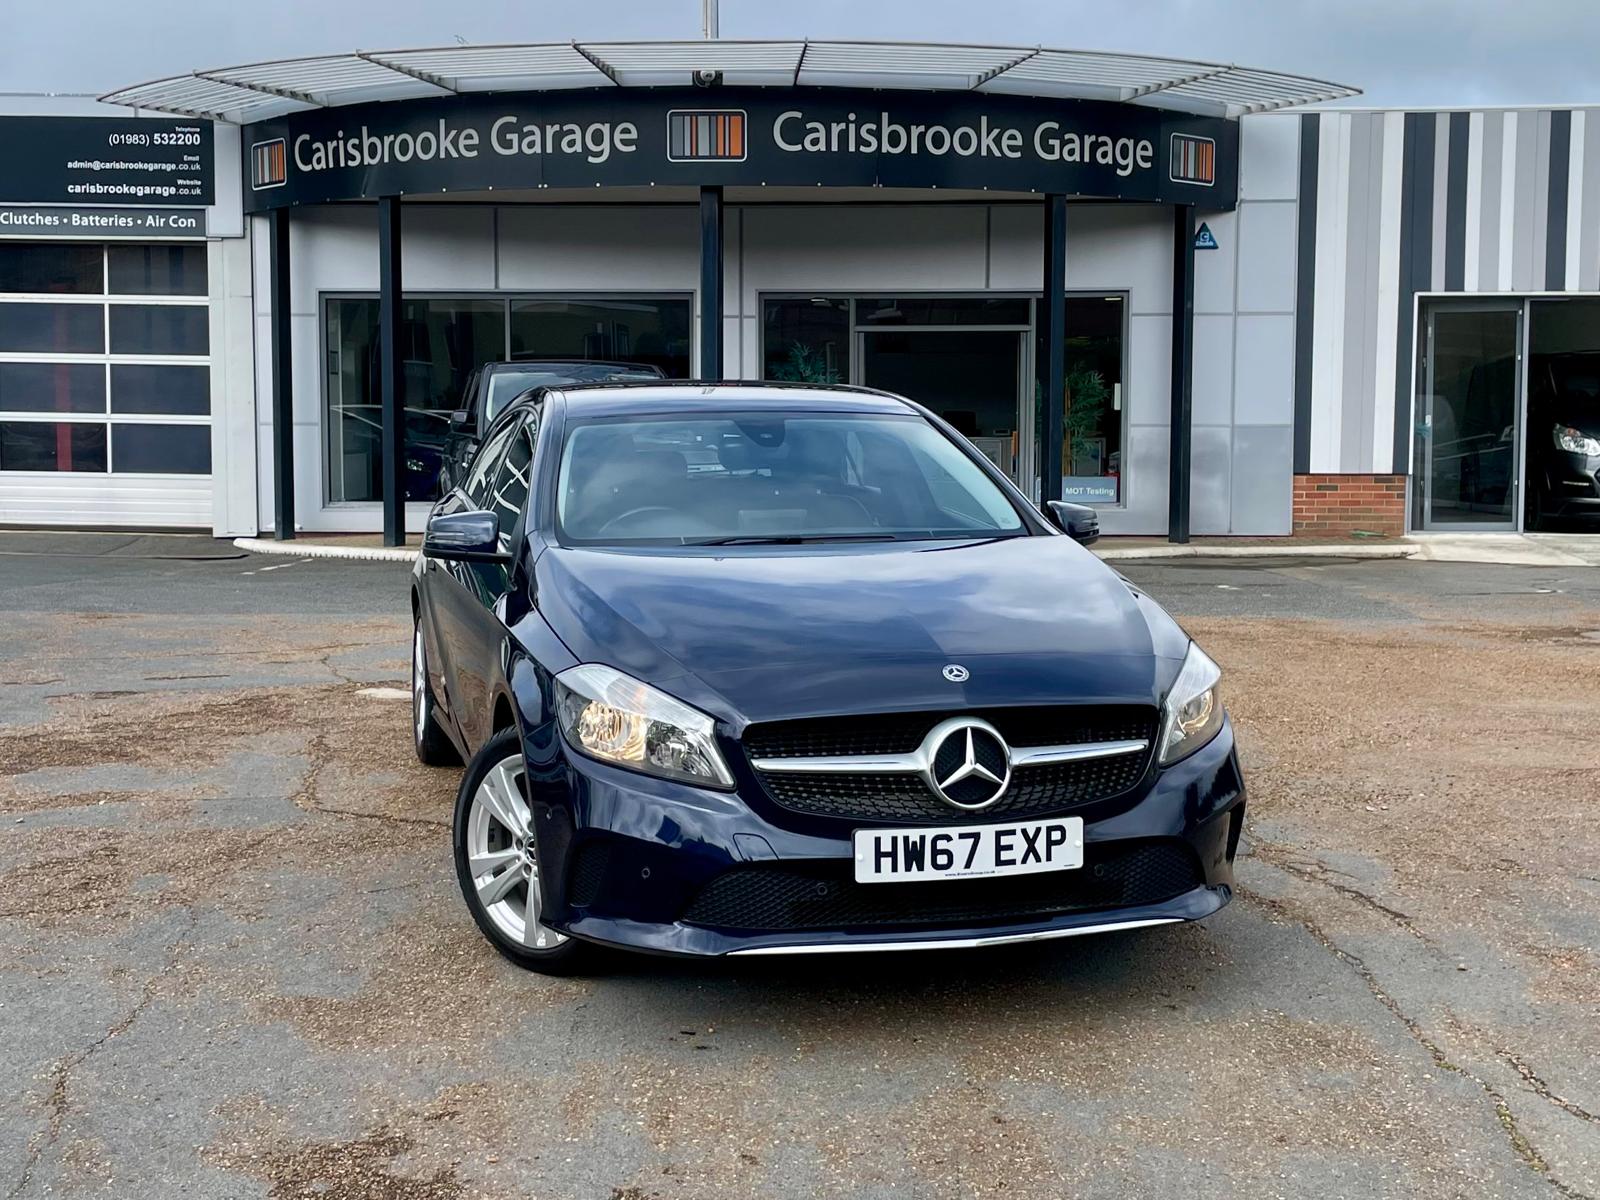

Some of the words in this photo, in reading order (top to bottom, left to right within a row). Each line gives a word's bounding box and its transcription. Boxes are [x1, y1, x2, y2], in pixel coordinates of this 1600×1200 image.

[108, 133, 150, 147] (01983)
[153, 133, 201, 145] 532200
[294, 118, 480, 172] Carisbrooke
[491, 115, 639, 164] Garage
[772, 111, 1024, 158] Carisbrooke
[1033, 121, 1154, 176] Garage
[67, 160, 201, 172] admin@carisbrookegarage.co.uk
[67, 183, 202, 197] carisbrookegarage.co.uk
[0, 212, 60, 226] Clutches
[71, 213, 134, 228] Batteries
[145, 215, 166, 228] Air
[168, 215, 196, 228] Con
[1065, 487, 1084, 495] MOT
[1086, 487, 1115, 496] Testing
[874, 831, 981, 874] HW67
[994, 824, 1067, 867] EXP
